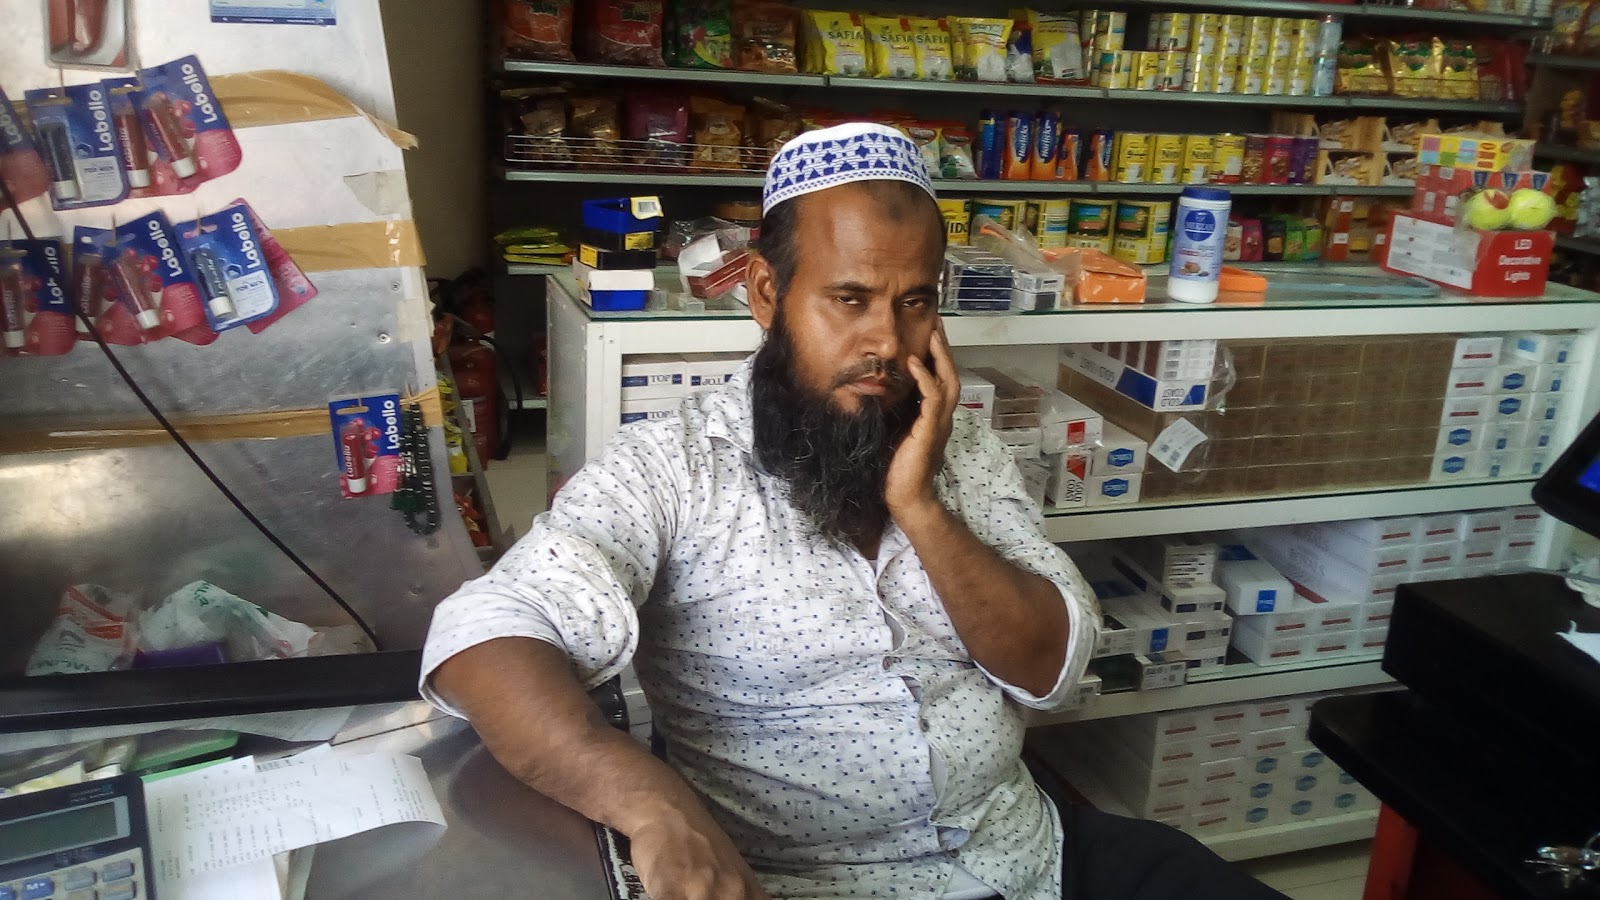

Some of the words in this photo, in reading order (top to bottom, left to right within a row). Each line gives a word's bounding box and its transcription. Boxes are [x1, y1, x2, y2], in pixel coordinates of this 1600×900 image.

[828, 30, 864, 40] SAFIA
[181, 63, 218, 124] Labello
[89, 90, 115, 152] Labello
[148, 219, 183, 277] Labello
[232, 212, 261, 269] Labello
[1514, 239, 1533, 250] LED
[650, 375, 671, 383] TOP
[382, 399, 400, 450] Labello
[650, 410, 671, 419] TOP
